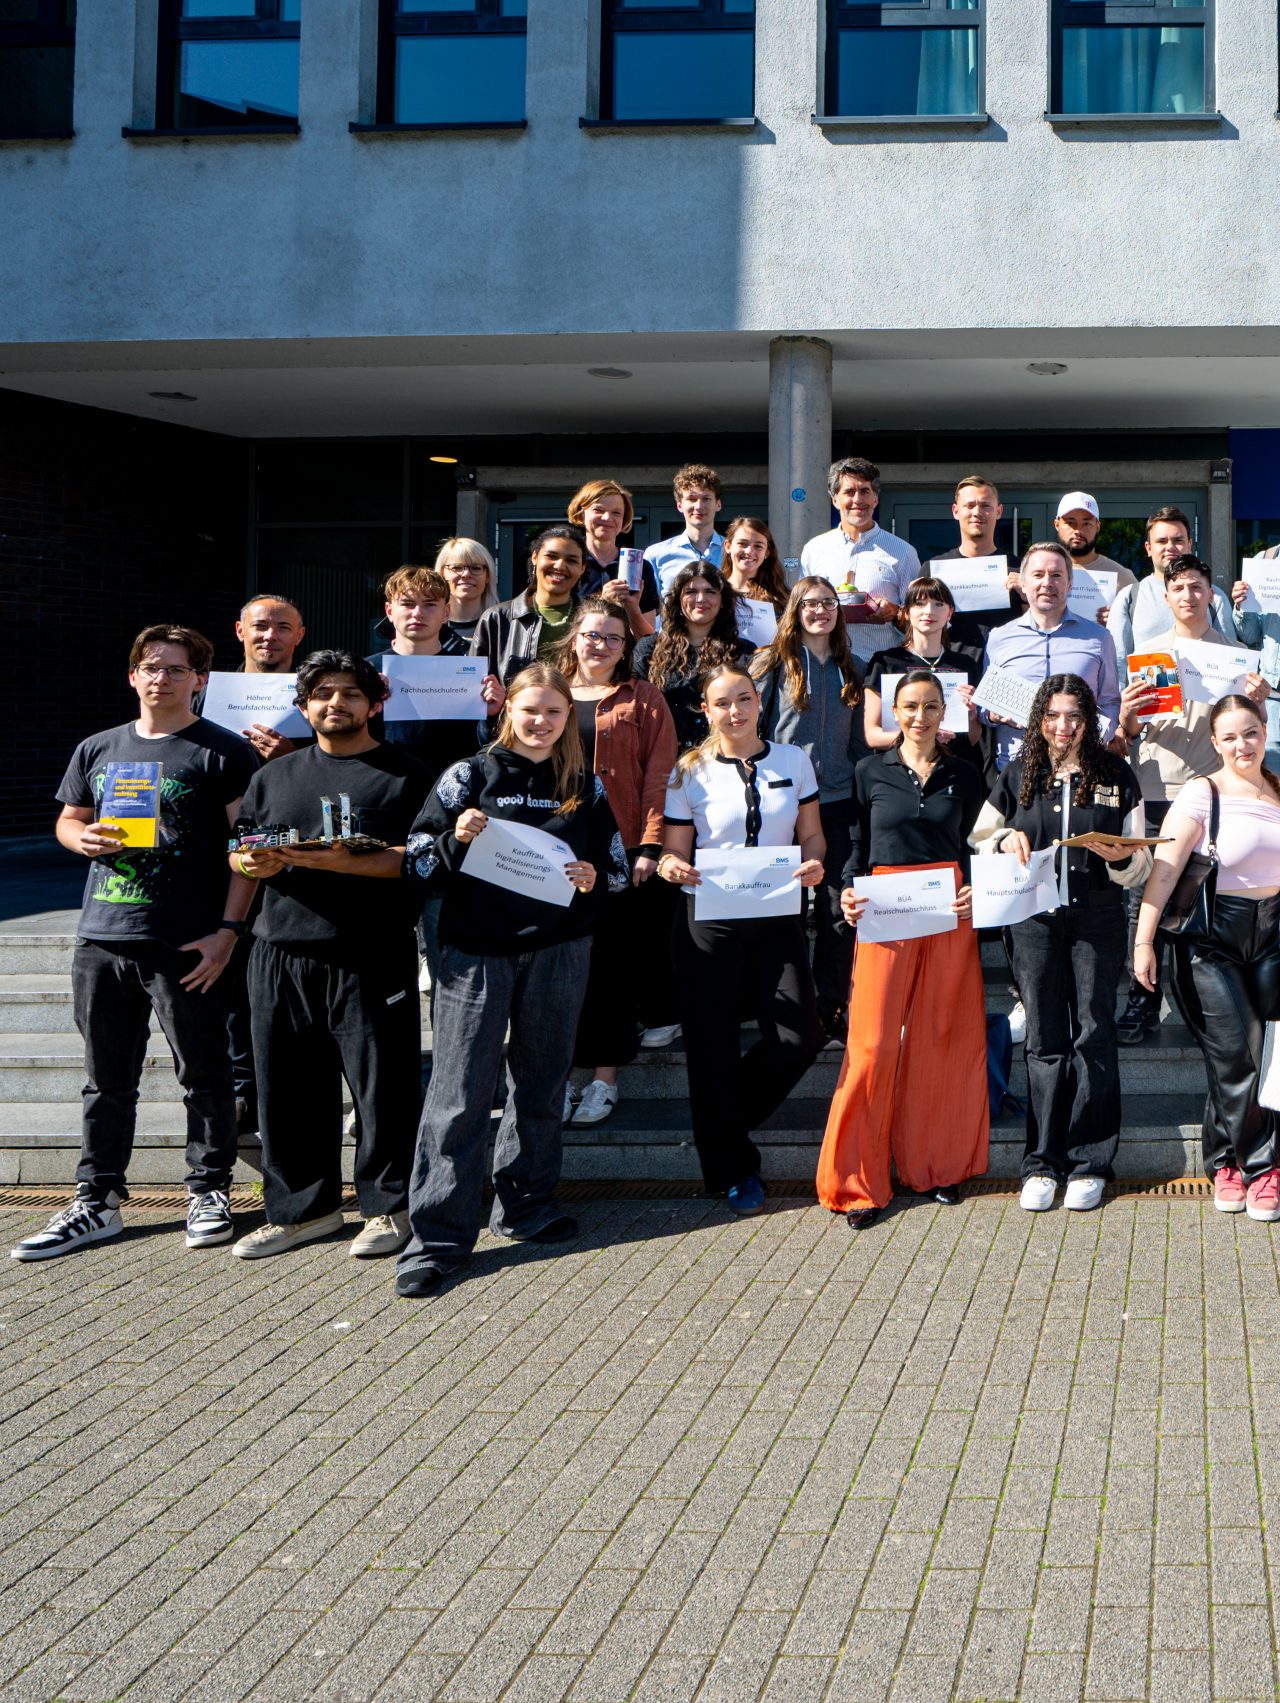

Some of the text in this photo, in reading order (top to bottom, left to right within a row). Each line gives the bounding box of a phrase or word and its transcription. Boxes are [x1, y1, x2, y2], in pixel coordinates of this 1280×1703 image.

[496, 794, 524, 807] good
[512, 848, 544, 860] Kauffrau
[495, 852, 554, 873] Digitalisierungs-
[496, 862, 546, 882] Management
[724, 881, 771, 890] Bankkauffrau
[874, 906, 937, 916] Realschulabschluss
